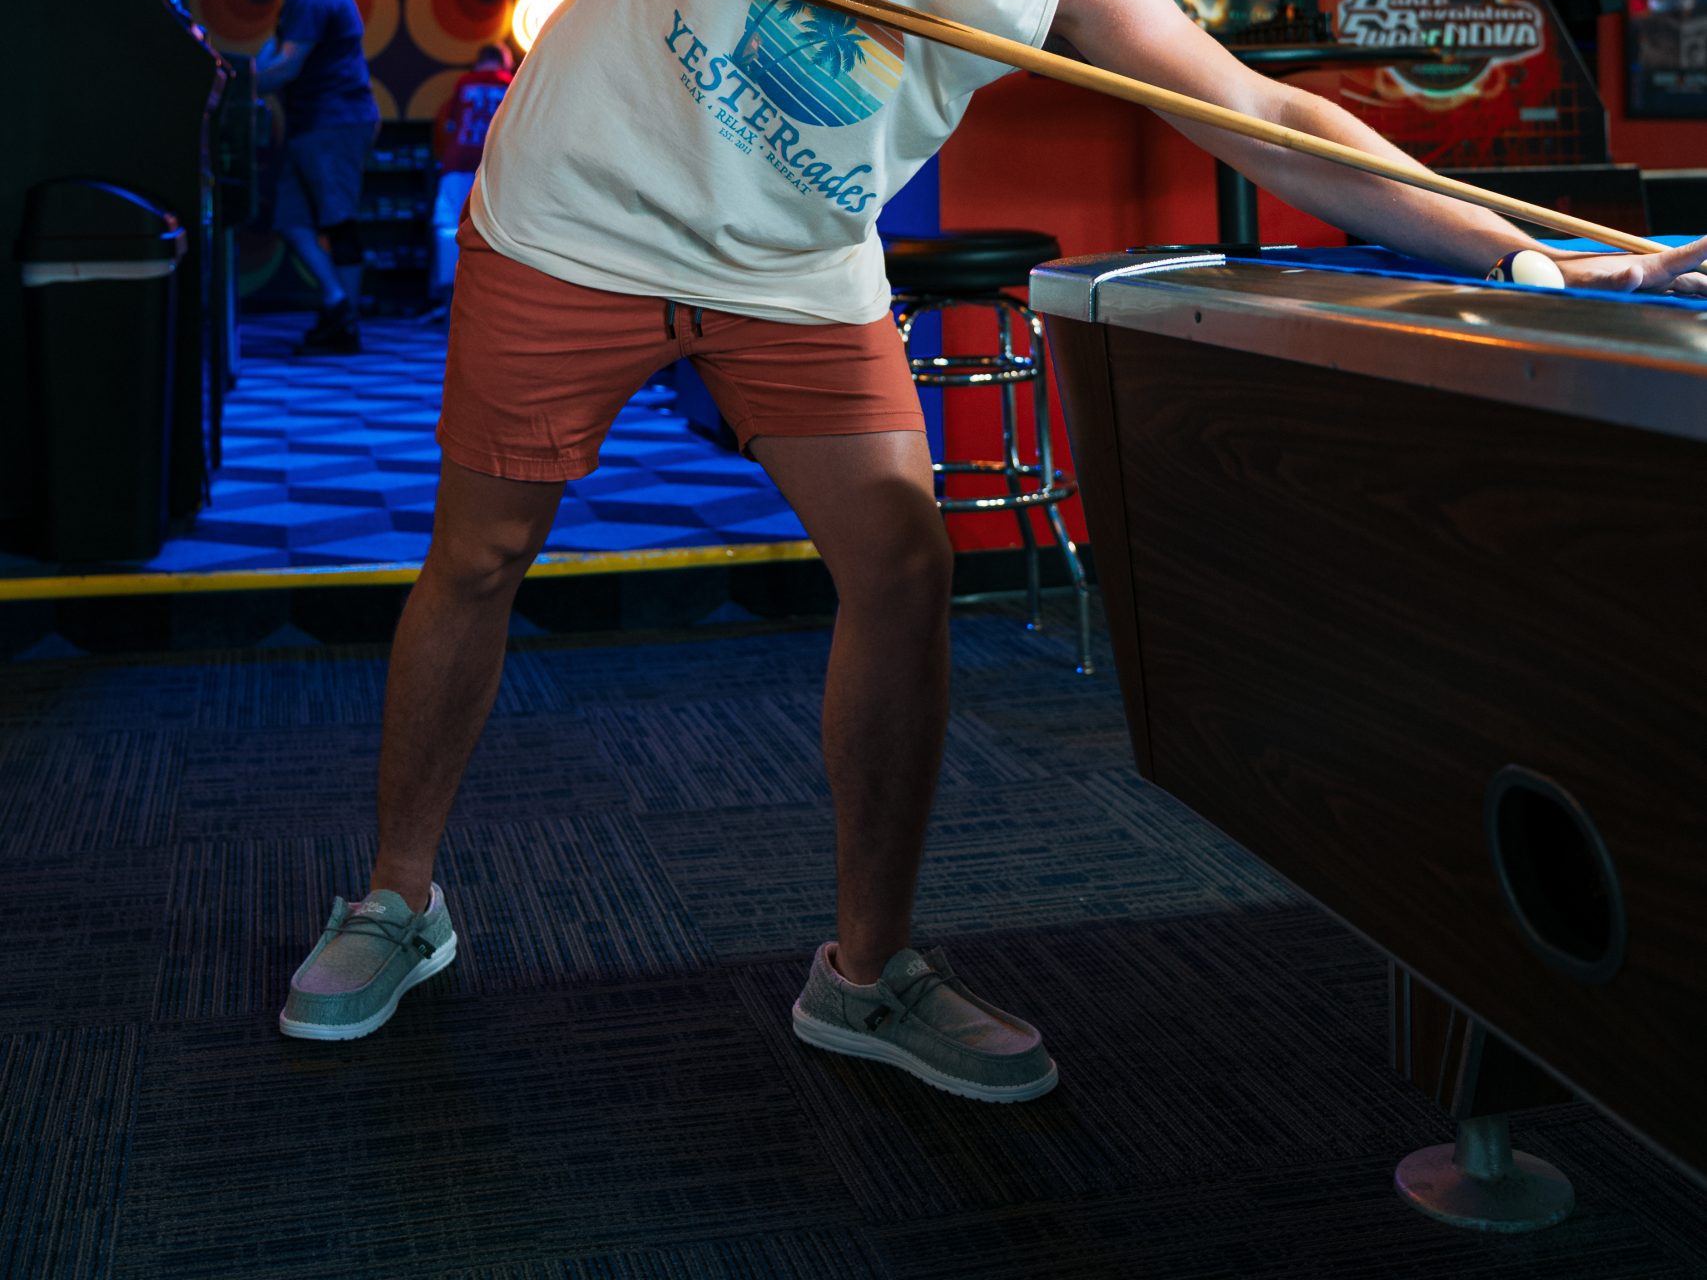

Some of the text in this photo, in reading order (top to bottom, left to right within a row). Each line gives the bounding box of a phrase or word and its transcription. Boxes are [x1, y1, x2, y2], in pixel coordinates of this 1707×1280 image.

[680, 73, 812, 196] PLAY RELAX REPEAT
[718, 127, 753, 155] EST. 2011
